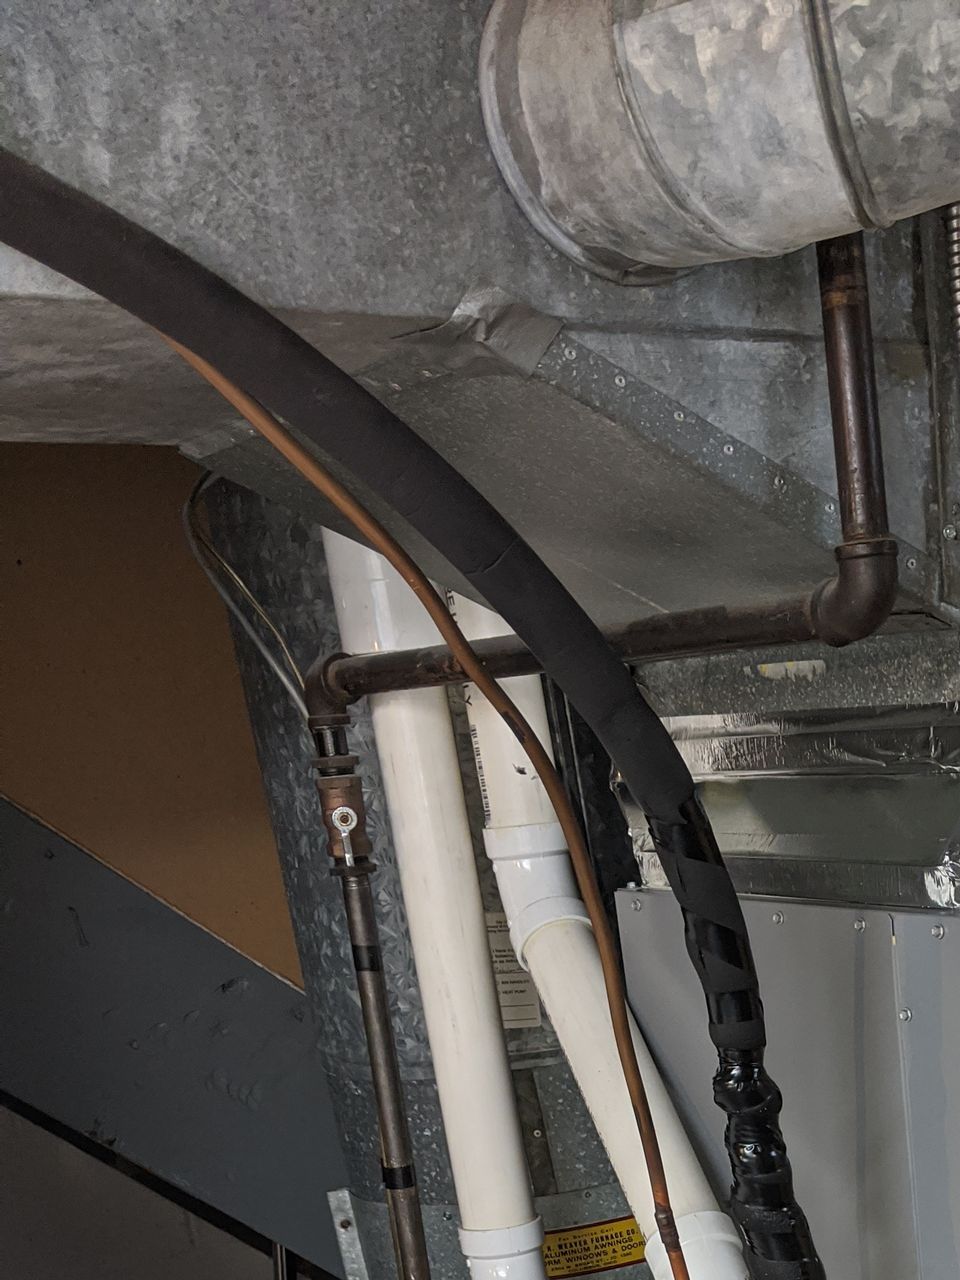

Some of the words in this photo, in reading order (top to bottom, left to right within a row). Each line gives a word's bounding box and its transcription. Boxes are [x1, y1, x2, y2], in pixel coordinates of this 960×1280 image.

[544, 1245, 591, 1259] ALUMINUM
[594, 1236, 634, 1250] AWNINGS
[558, 1239, 588, 1250] WEAVER
[590, 1232, 624, 1244] FURNACE
[626, 1228, 639, 1236] CO.
[565, 1250, 609, 1263] WINDOWS
